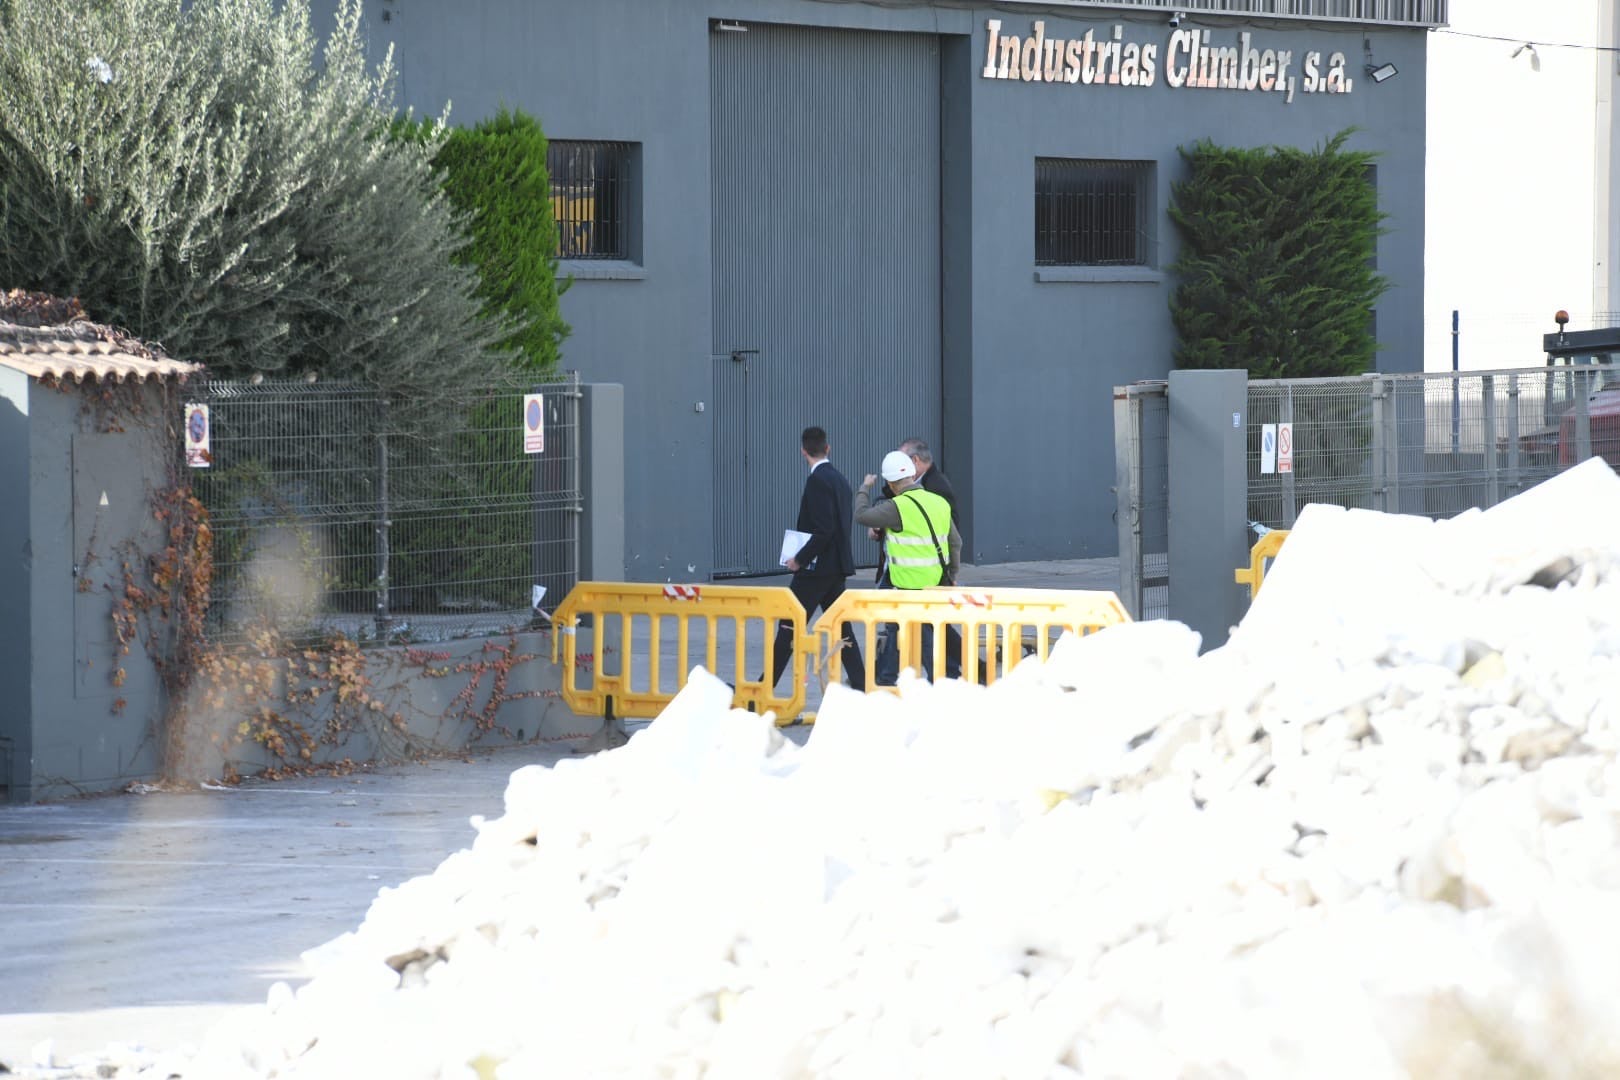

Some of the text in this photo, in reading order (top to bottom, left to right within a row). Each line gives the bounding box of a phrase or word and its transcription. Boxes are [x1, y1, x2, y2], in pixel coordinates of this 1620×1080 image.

[982, 19, 1353, 104] Industrias Climber, s.a.
